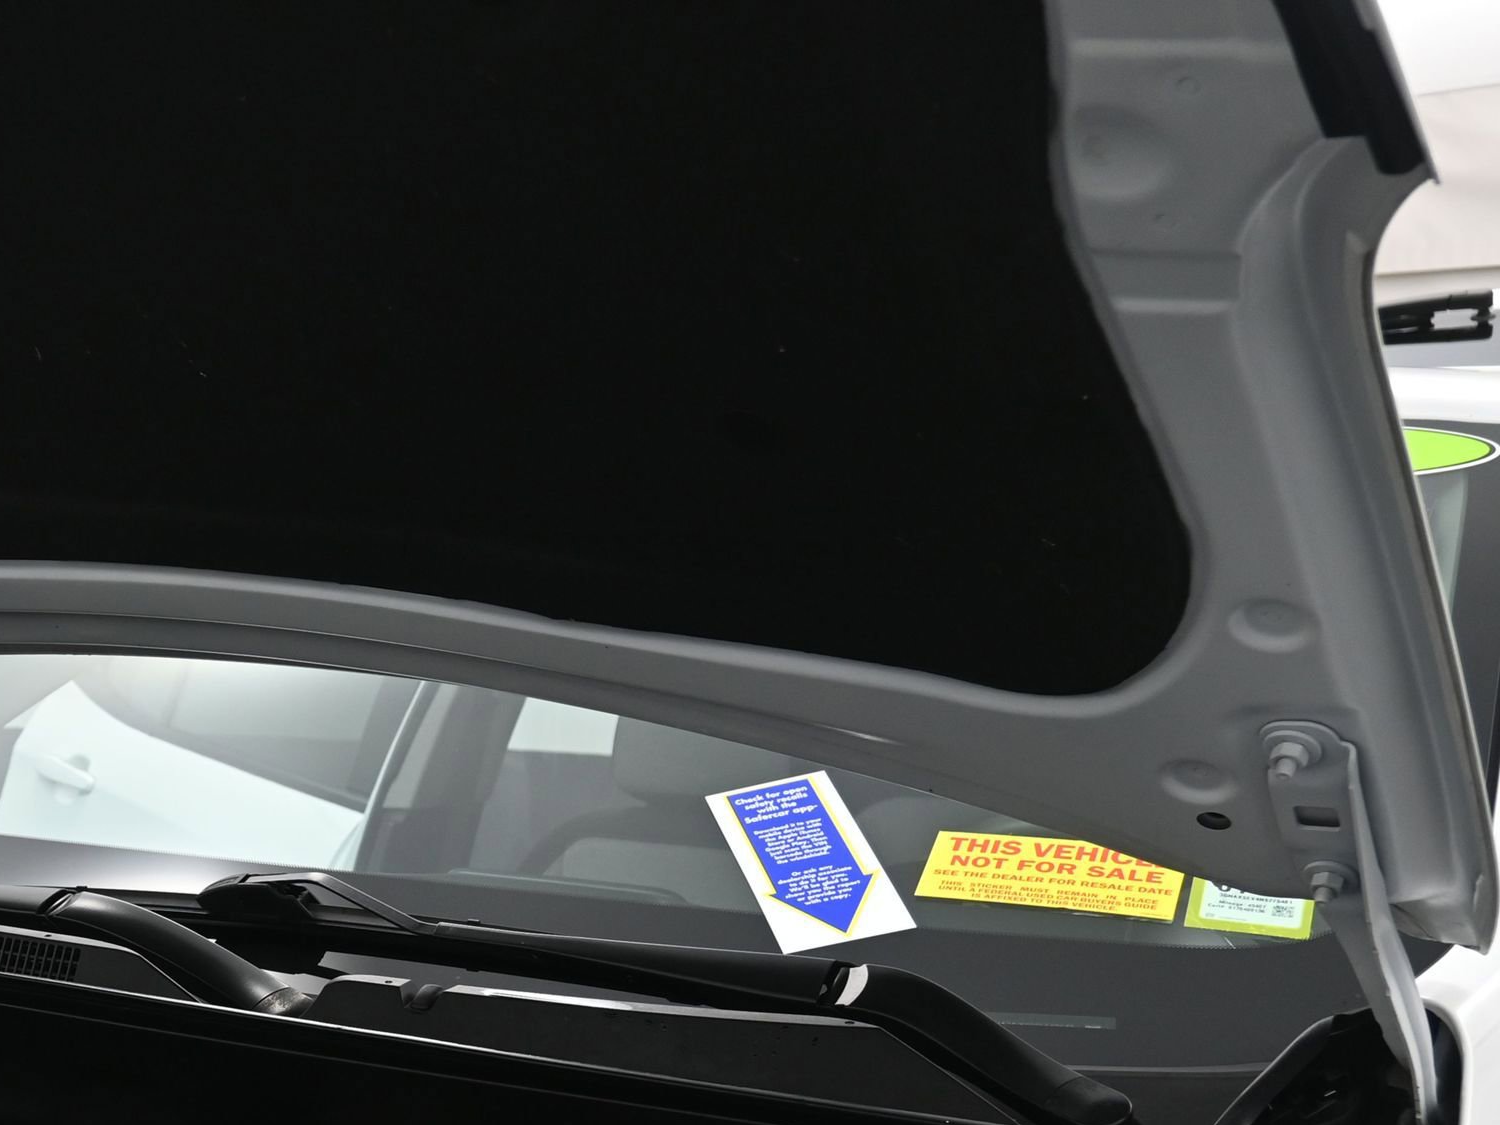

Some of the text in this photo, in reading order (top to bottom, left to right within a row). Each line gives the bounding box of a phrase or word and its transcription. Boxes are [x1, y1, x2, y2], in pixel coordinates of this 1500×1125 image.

[735, 794, 764, 805] Check
[783, 786, 808, 795] open
[744, 792, 808, 810] safety recalls
[744, 810, 789, 824] Safercar
[756, 805, 779, 813] with
[950, 837, 1164, 868] THIS VEHIC
[950, 855, 1165, 884] NOT FOR SALE
[992, 873, 1044, 884] DEALER
[1048, 878, 1076, 886] FOR
[1080, 881, 1134, 892] RESALE
[1138, 887, 1173, 896] DATE
[1020, 886, 1050, 894] MUST
[1057, 890, 1098, 898] REMAIN
[981, 888, 1026, 897] FEDERAL
[1026, 892, 1056, 900] USED
[1080, 896, 1122, 906] BUYERS
[1124, 902, 1157, 910] GUIDE
[984, 894, 1028, 903] AFFIXED
